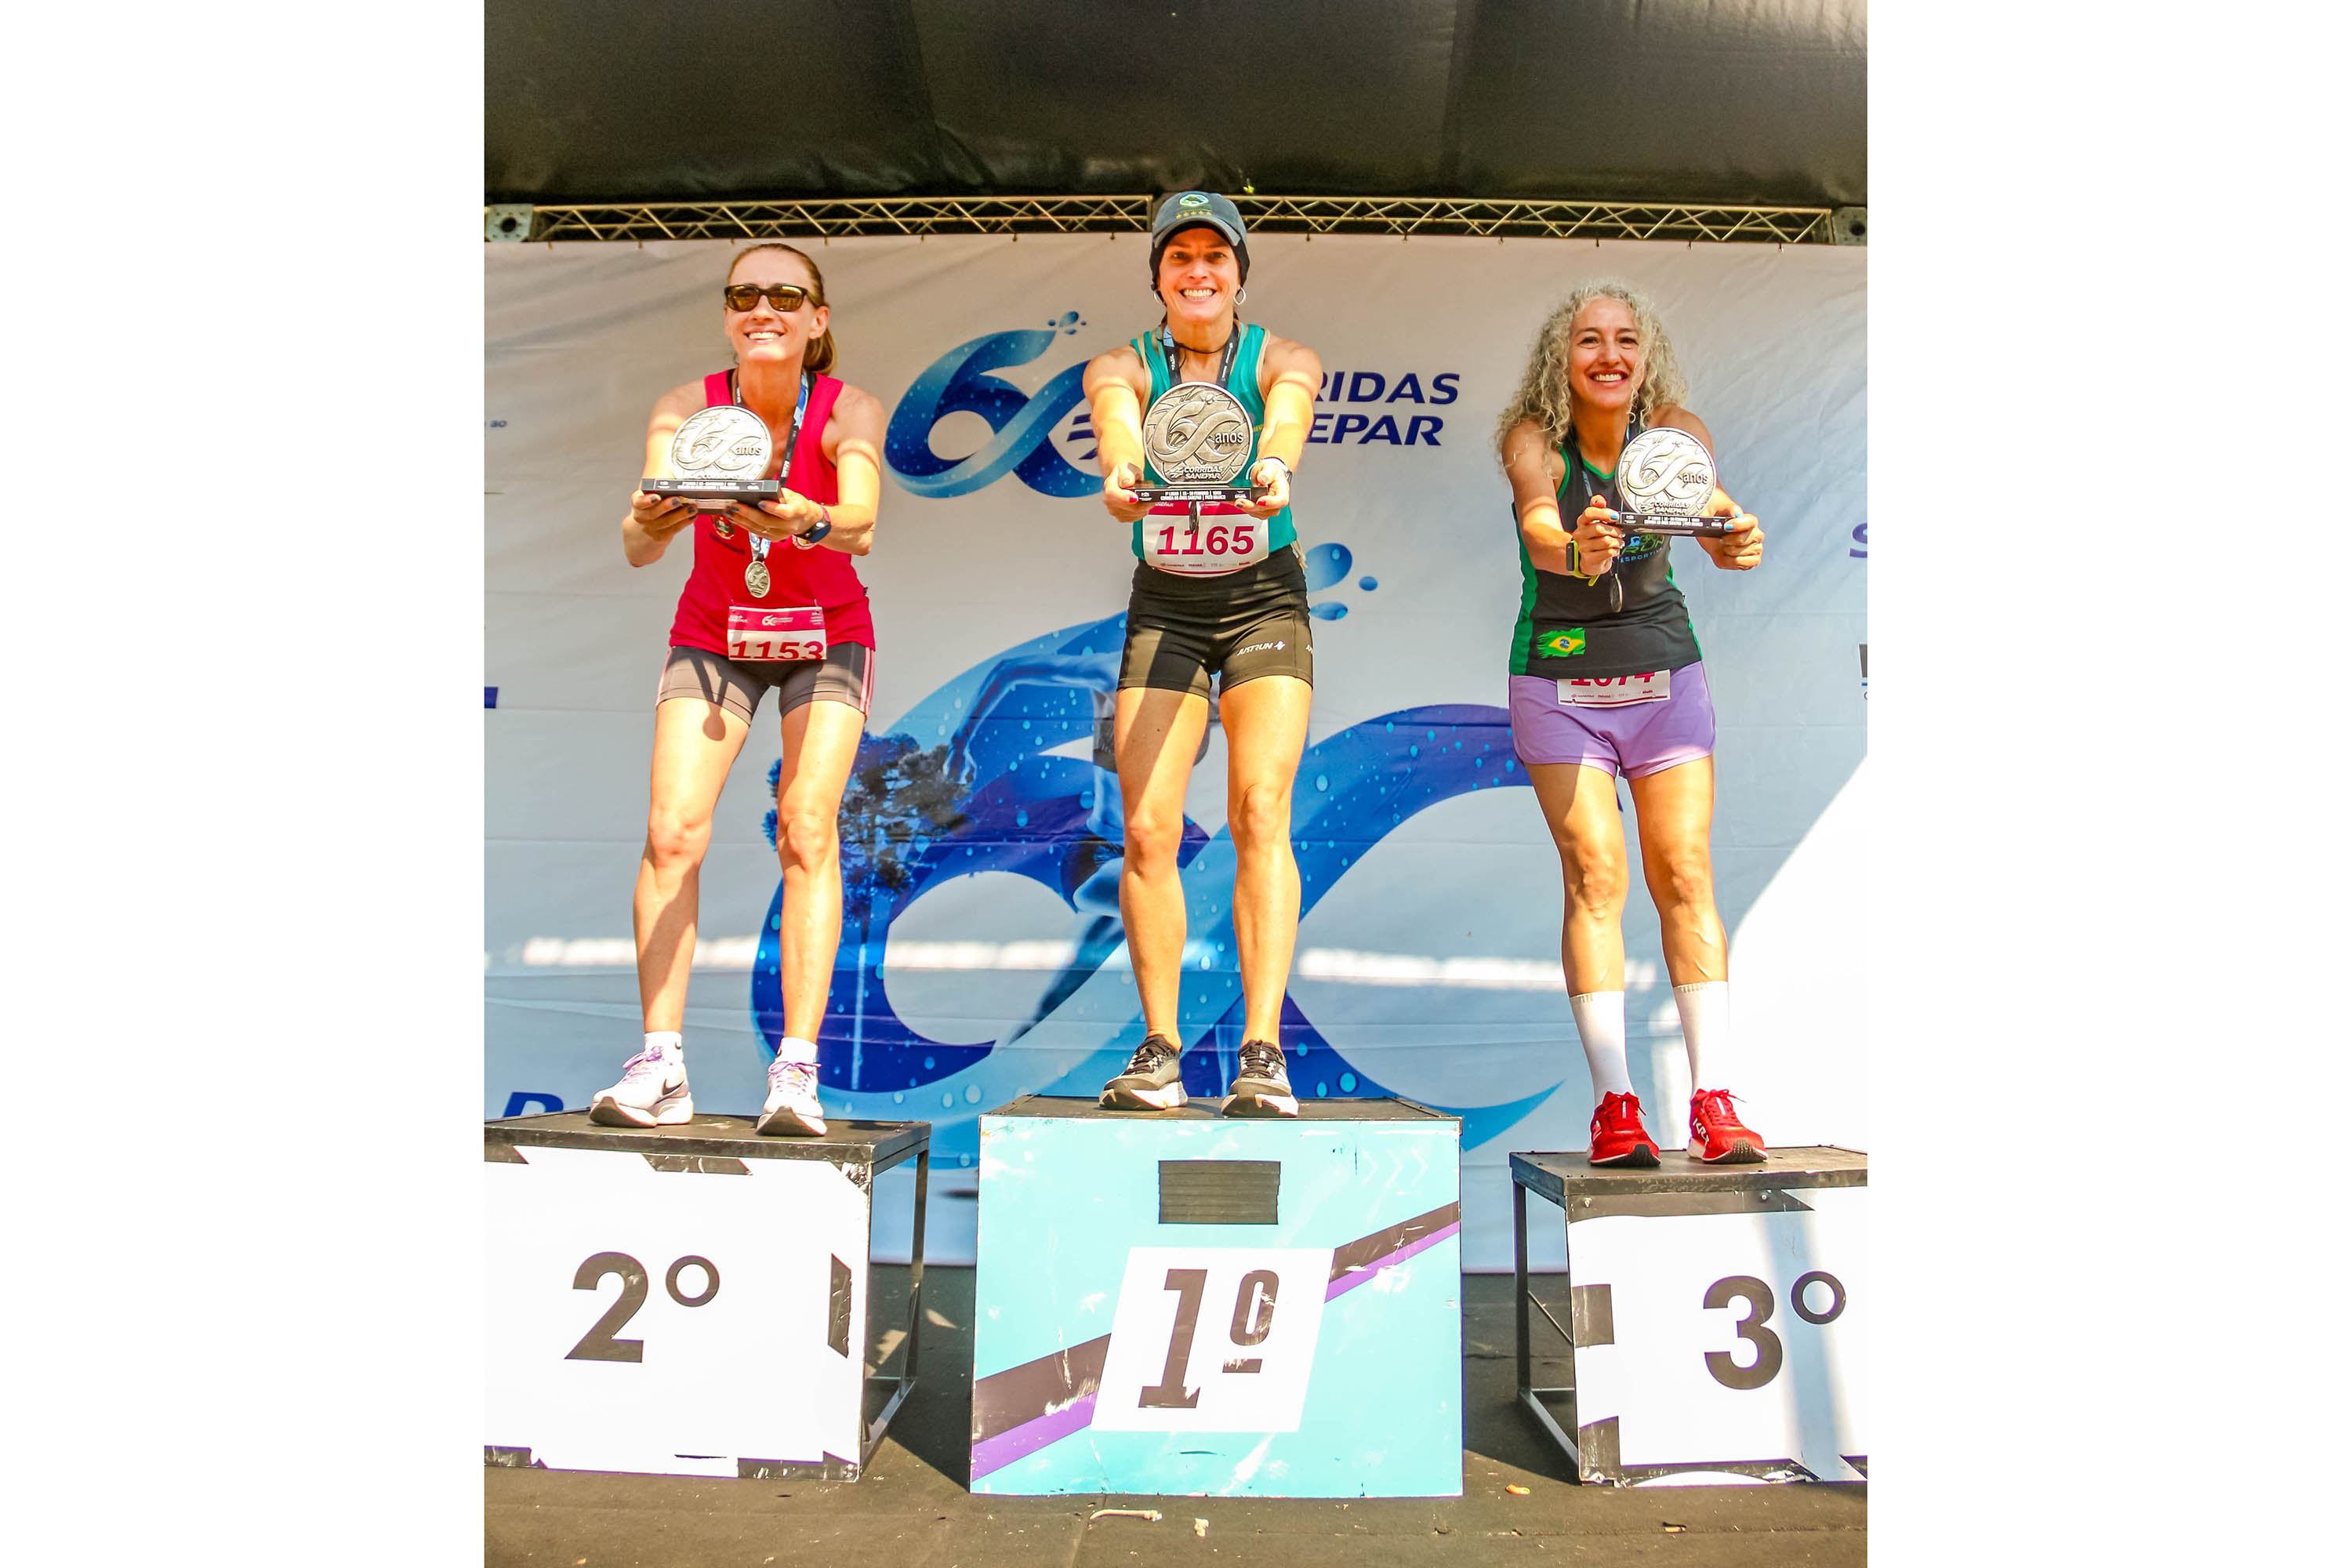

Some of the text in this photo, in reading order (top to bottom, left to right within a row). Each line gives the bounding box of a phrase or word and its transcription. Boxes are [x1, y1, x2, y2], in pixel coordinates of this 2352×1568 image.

[1315, 371, 1461, 405] IDAS
[1215, 432, 1244, 444] anos
[735, 446, 763, 456] anos
[1682, 472, 1708, 485] anos
[1157, 526, 1254, 555] 1165
[730, 641, 823, 659] 1153
[1237, 643, 1273, 656] JUSTRUN
